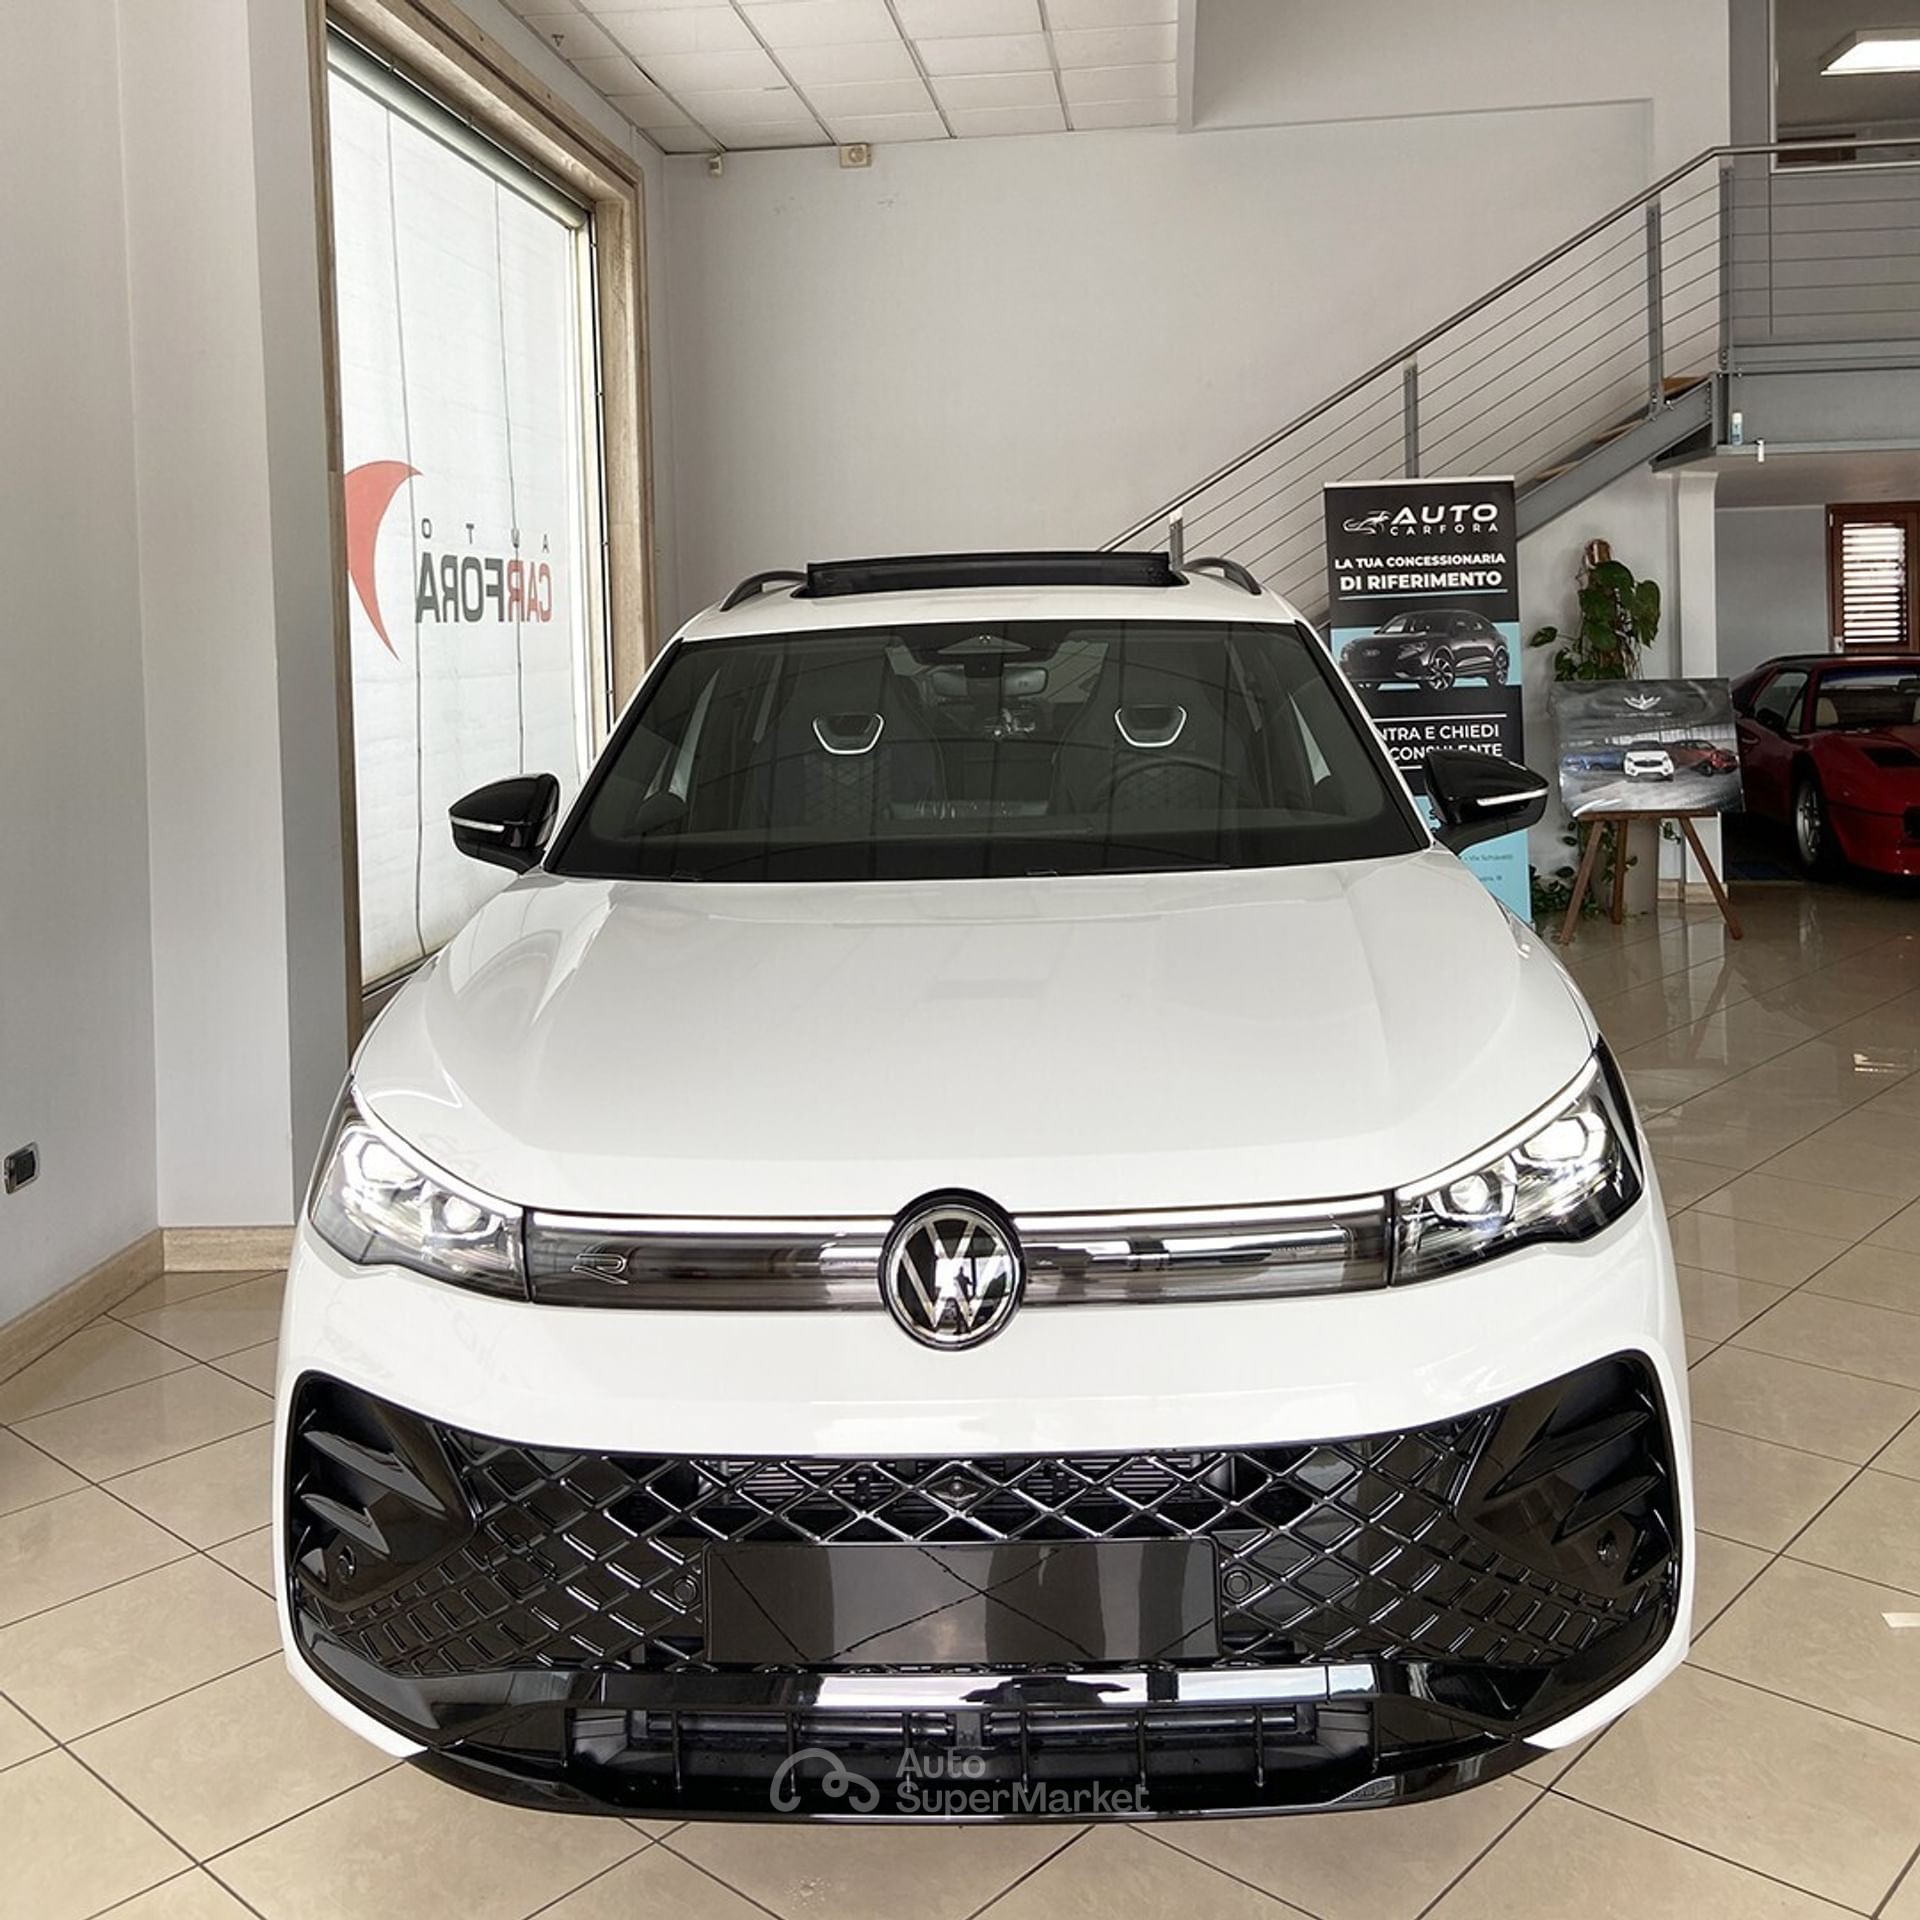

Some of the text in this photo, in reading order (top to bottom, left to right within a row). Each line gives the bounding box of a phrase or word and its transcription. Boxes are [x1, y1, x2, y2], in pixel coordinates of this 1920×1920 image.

[1390, 503, 1499, 525] AUTO
[1389, 523, 1499, 536] CARFORA
[1335, 553, 1506, 570] LA TUA CONCESSIONARIA
[1340, 571, 1502, 591] DI RIFERIMENTO
[1380, 723, 1499, 741] NTRA E CHIEDI
[888, 1206, 1018, 1343] VW
